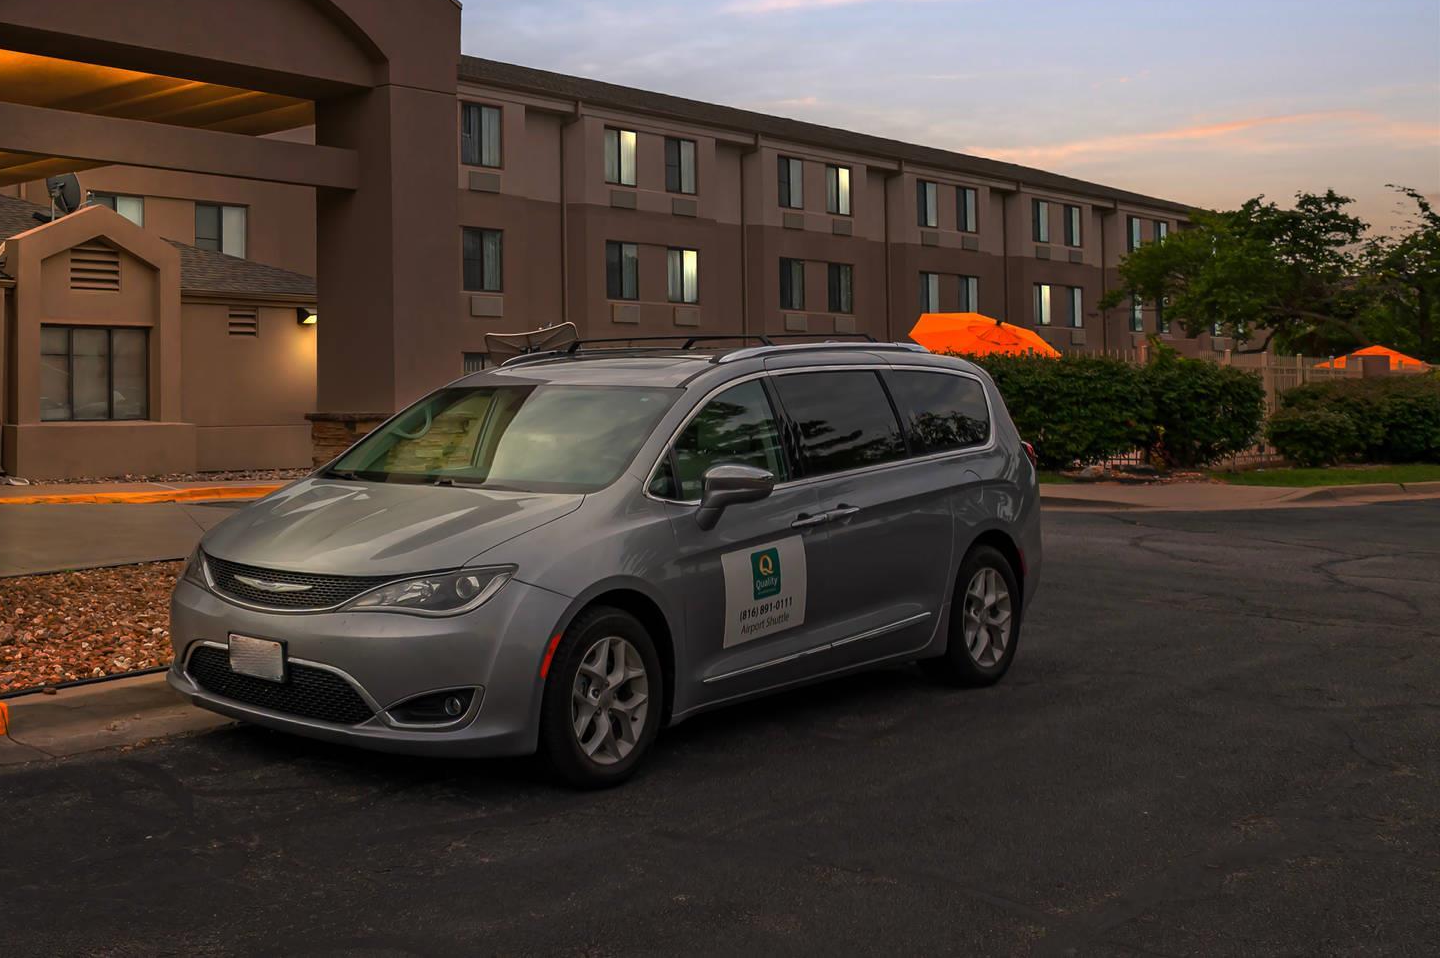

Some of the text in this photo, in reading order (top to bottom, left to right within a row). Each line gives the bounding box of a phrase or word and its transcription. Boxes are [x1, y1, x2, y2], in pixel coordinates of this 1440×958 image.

[755, 577, 778, 590] Quality
[740, 597, 793, 622] (816) 891-0111
[741, 612, 790, 635] Airport Shuttle
